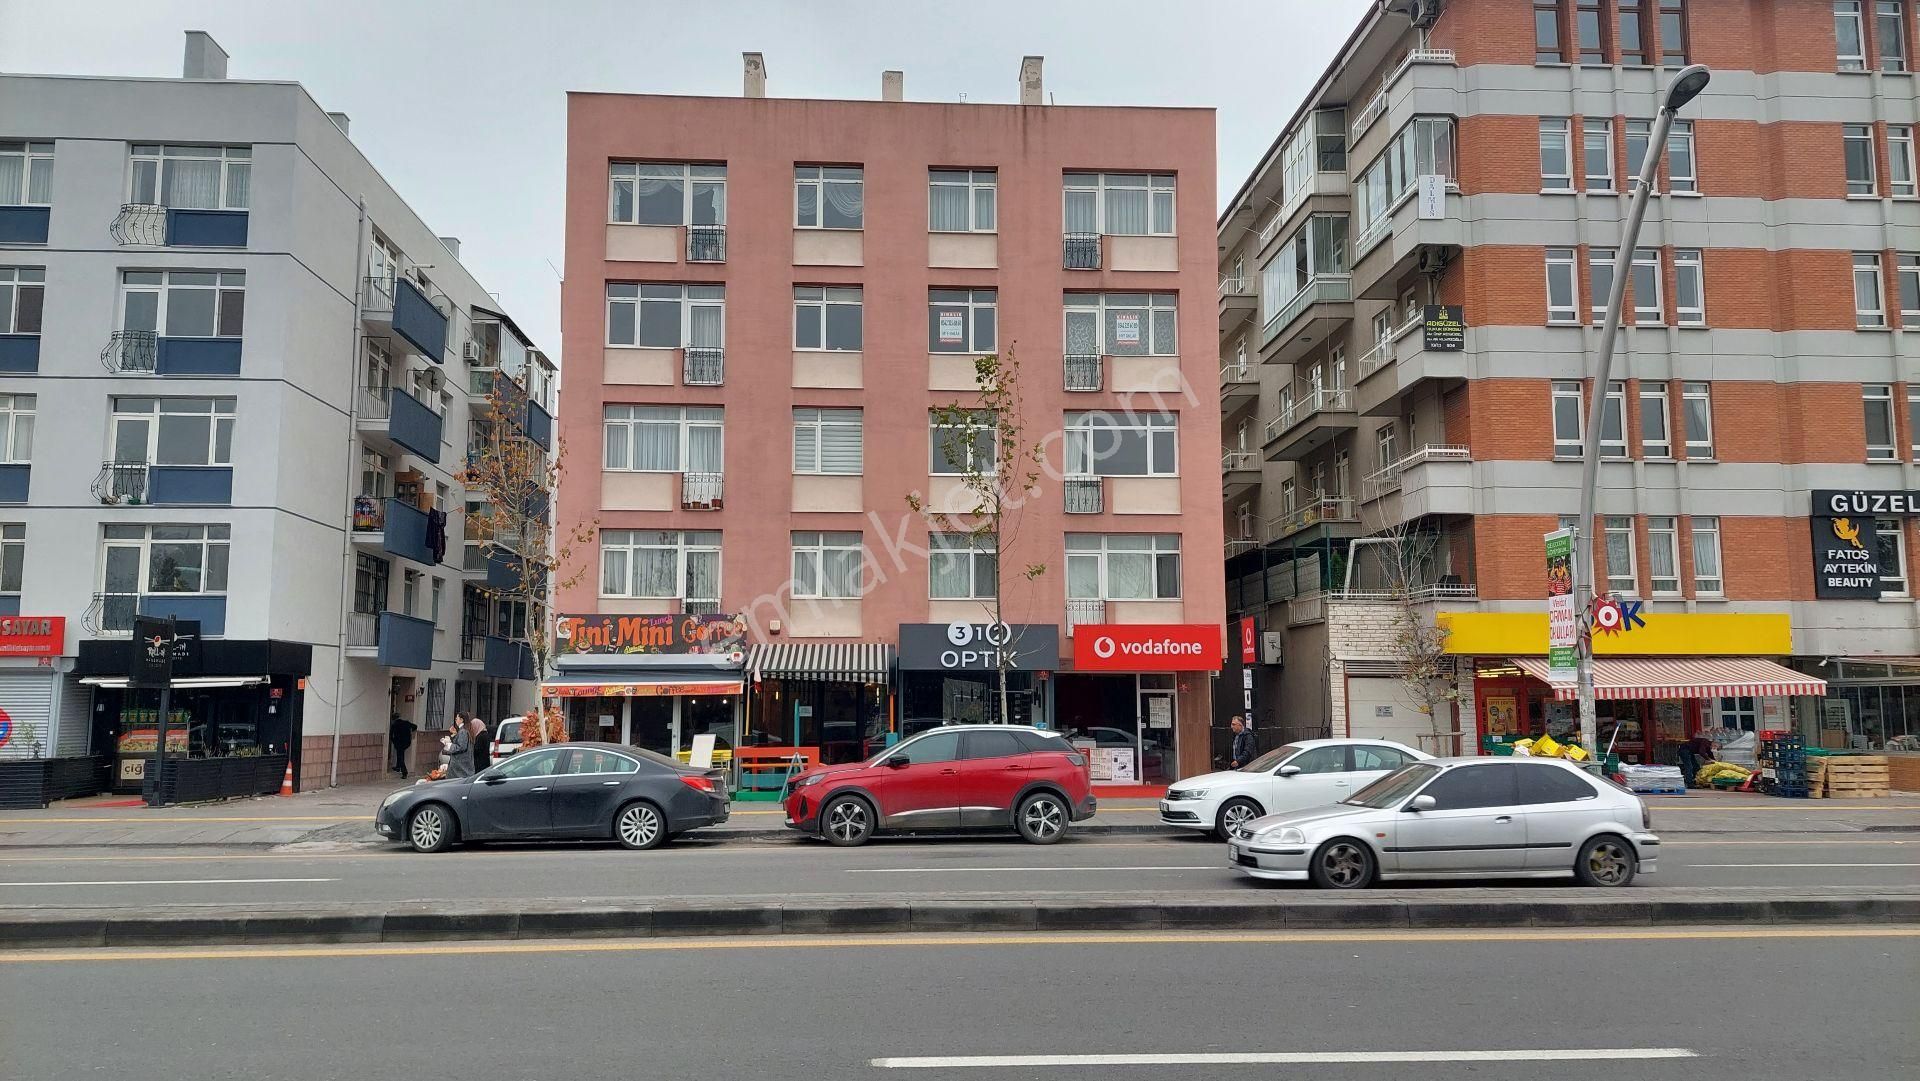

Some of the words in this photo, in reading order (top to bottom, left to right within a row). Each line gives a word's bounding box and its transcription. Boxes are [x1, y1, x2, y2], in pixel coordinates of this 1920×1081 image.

[1831, 491, 1920, 513] GÜZEL
[1827, 549, 1870, 561] FATOŞ
[1823, 562, 1877, 574] AYTEKİN
[1828, 577, 1873, 588] BEAUTY
[1591, 599, 1646, 633] OK
[0, 620, 52, 636] SAYAR
[616, 617, 674, 646] Mini
[1121, 638, 1202, 655] vodafone
